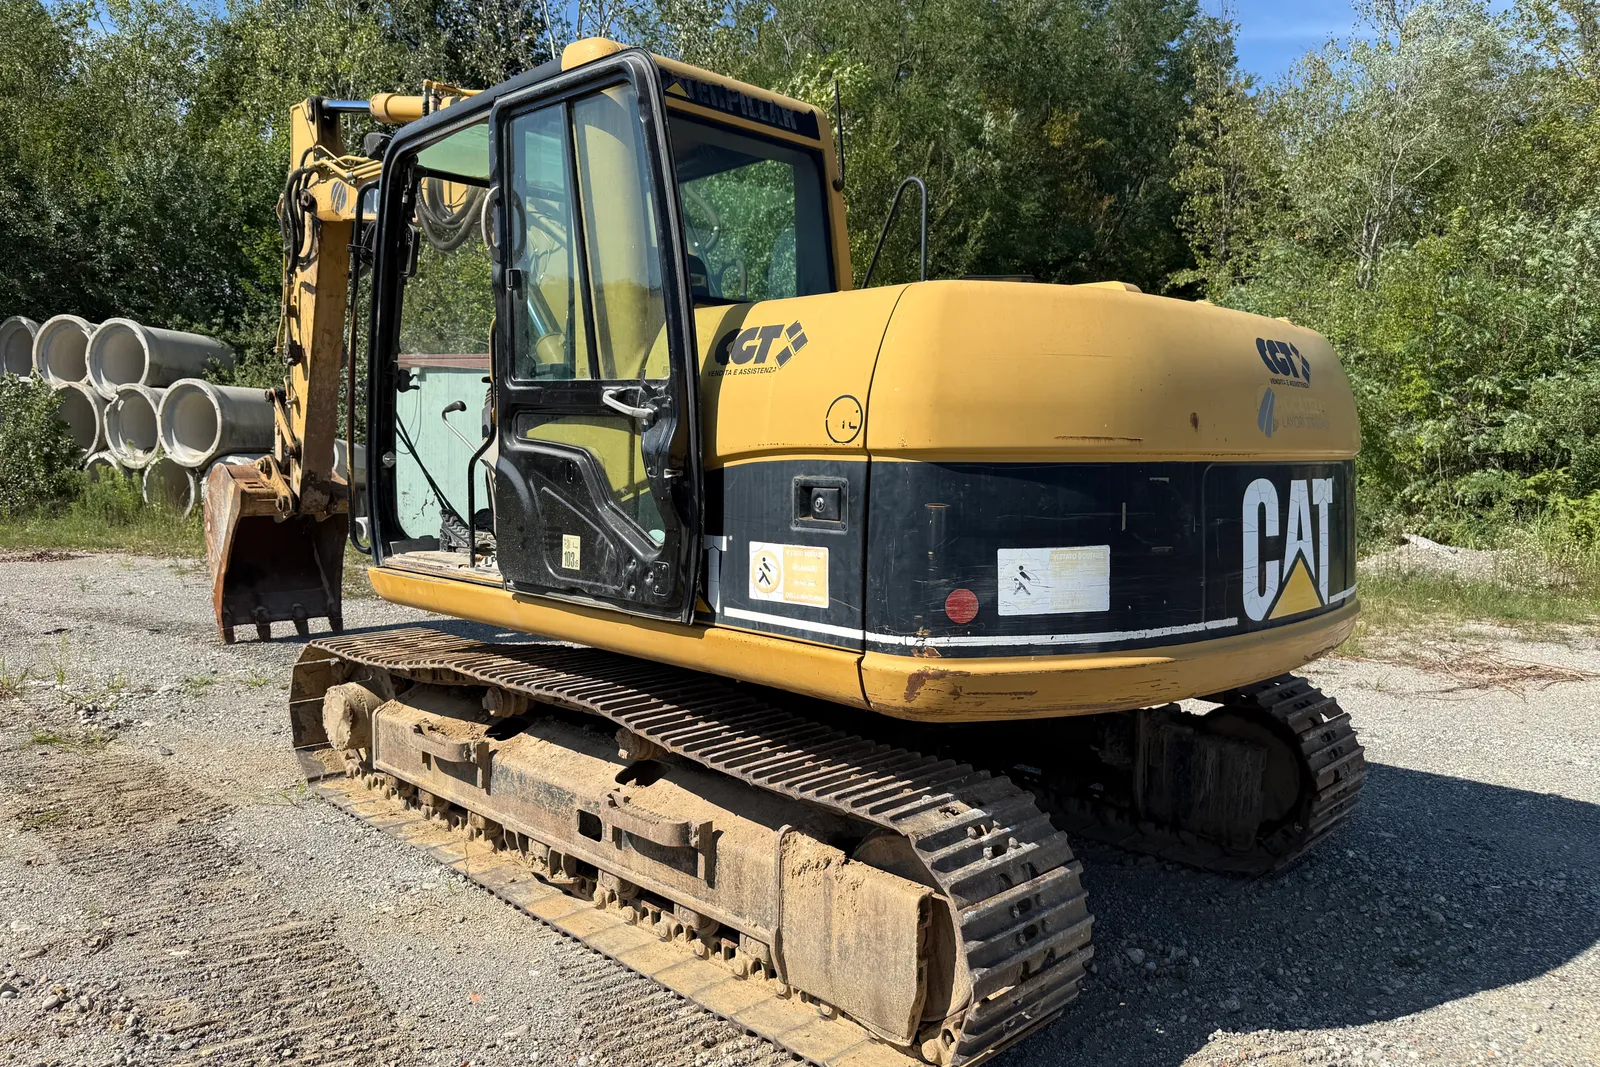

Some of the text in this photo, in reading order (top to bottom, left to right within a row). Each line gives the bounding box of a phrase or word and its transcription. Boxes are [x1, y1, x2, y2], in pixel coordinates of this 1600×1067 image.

[714, 324, 786, 366] CGT
[1255, 337, 1301, 379] CGT
[707, 369, 732, 377] VENDITA
[733, 368, 738, 376] E
[564, 551, 575, 568] 103
[1242, 477, 1333, 622] CAT
